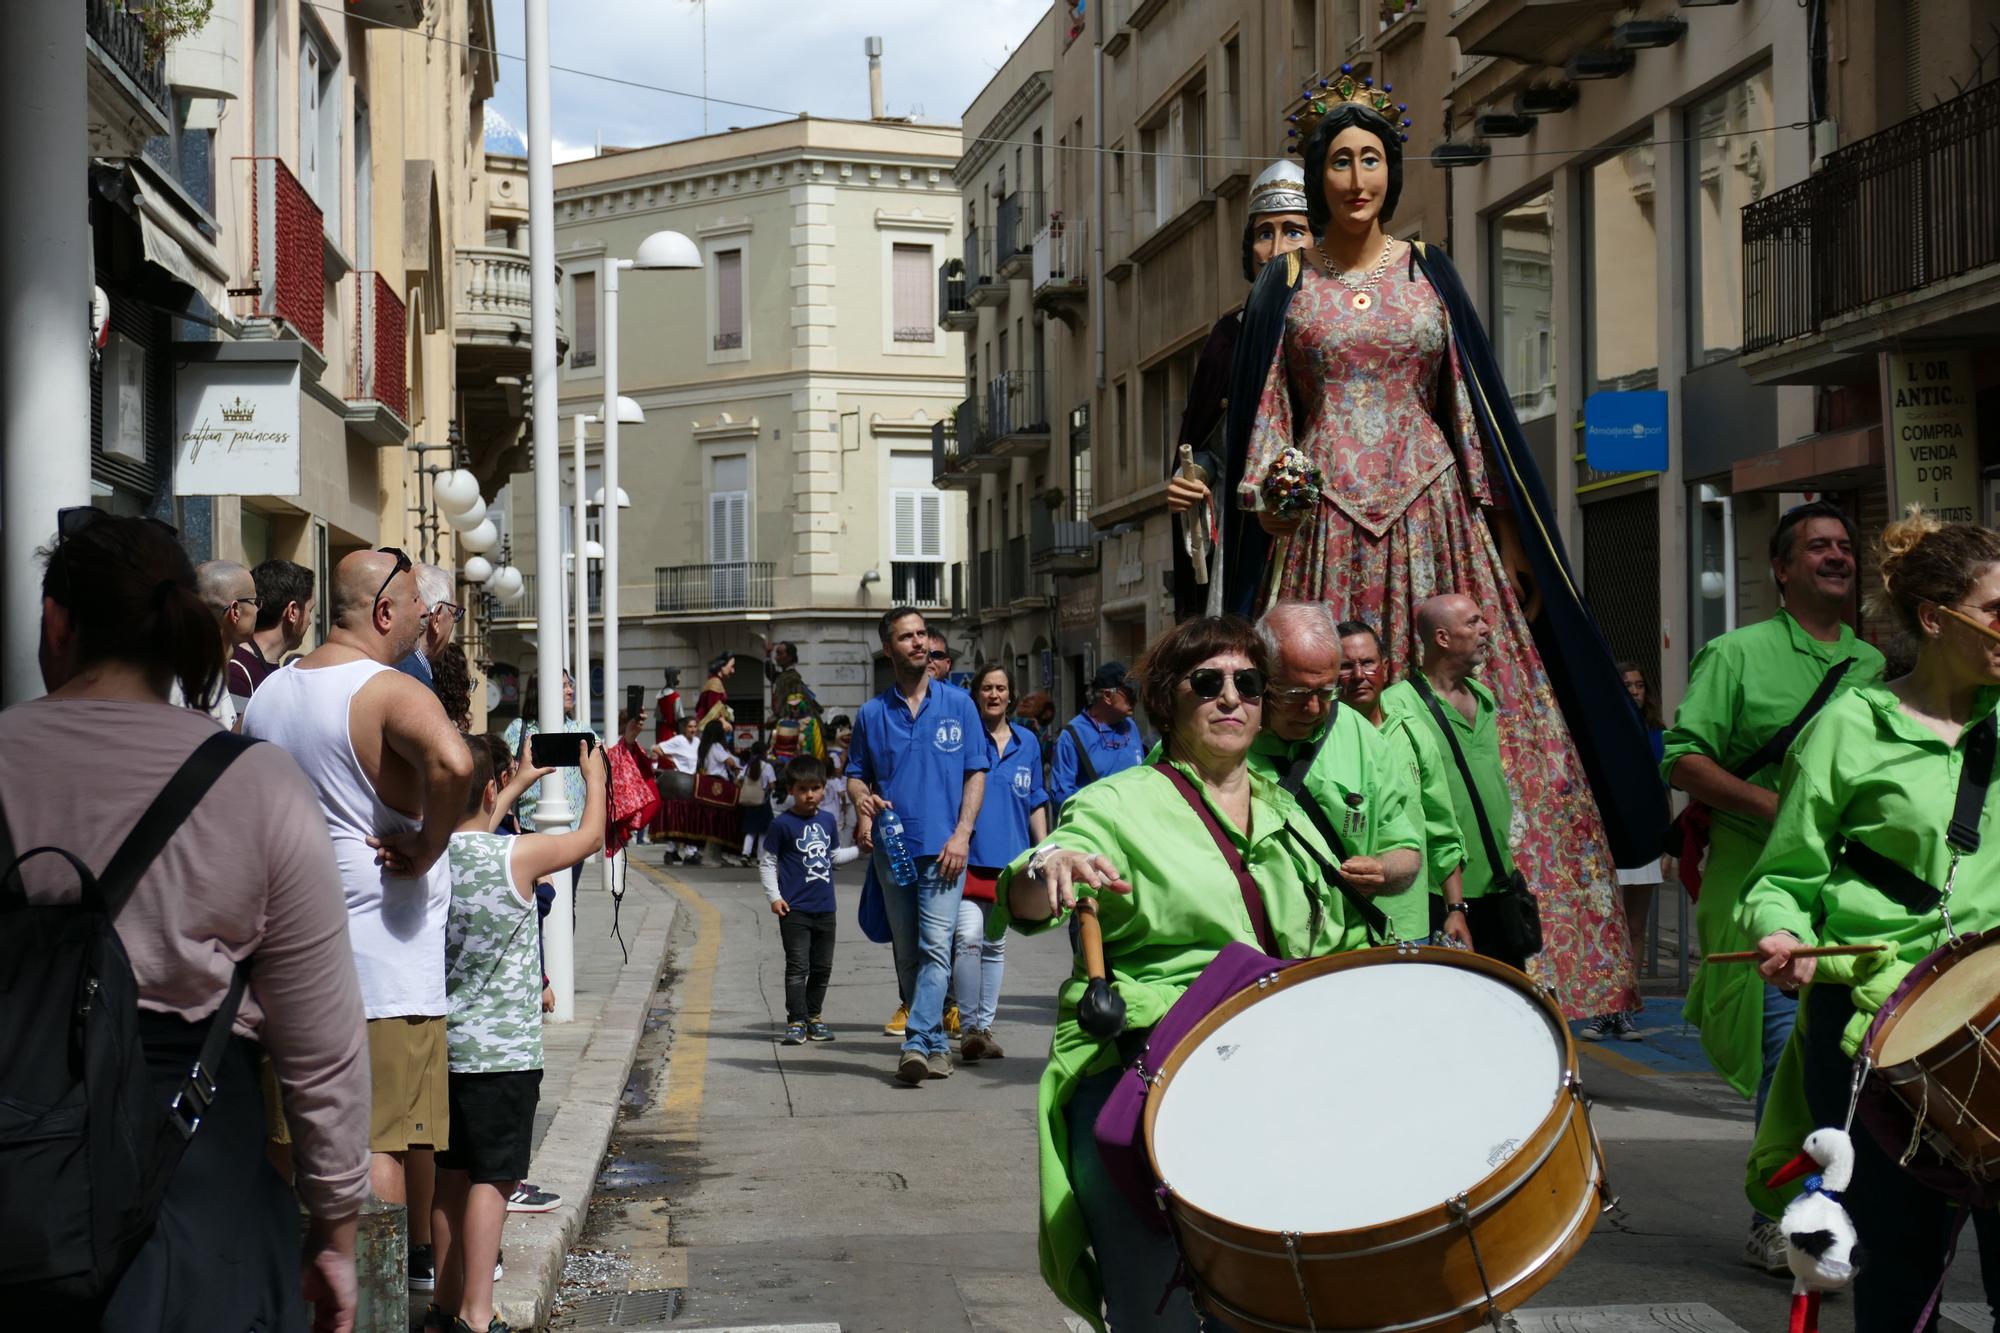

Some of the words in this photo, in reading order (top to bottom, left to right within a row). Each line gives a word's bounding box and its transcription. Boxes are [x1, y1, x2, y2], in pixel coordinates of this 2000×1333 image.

[1896, 385, 1953, 408] ANTIC
[1902, 423, 1964, 442] COMPRA
[227, 430, 291, 454] princess
[1910, 445, 1958, 462] VENDA
[1917, 466, 1953, 483] D'OR
[1933, 487, 1940, 503] i
